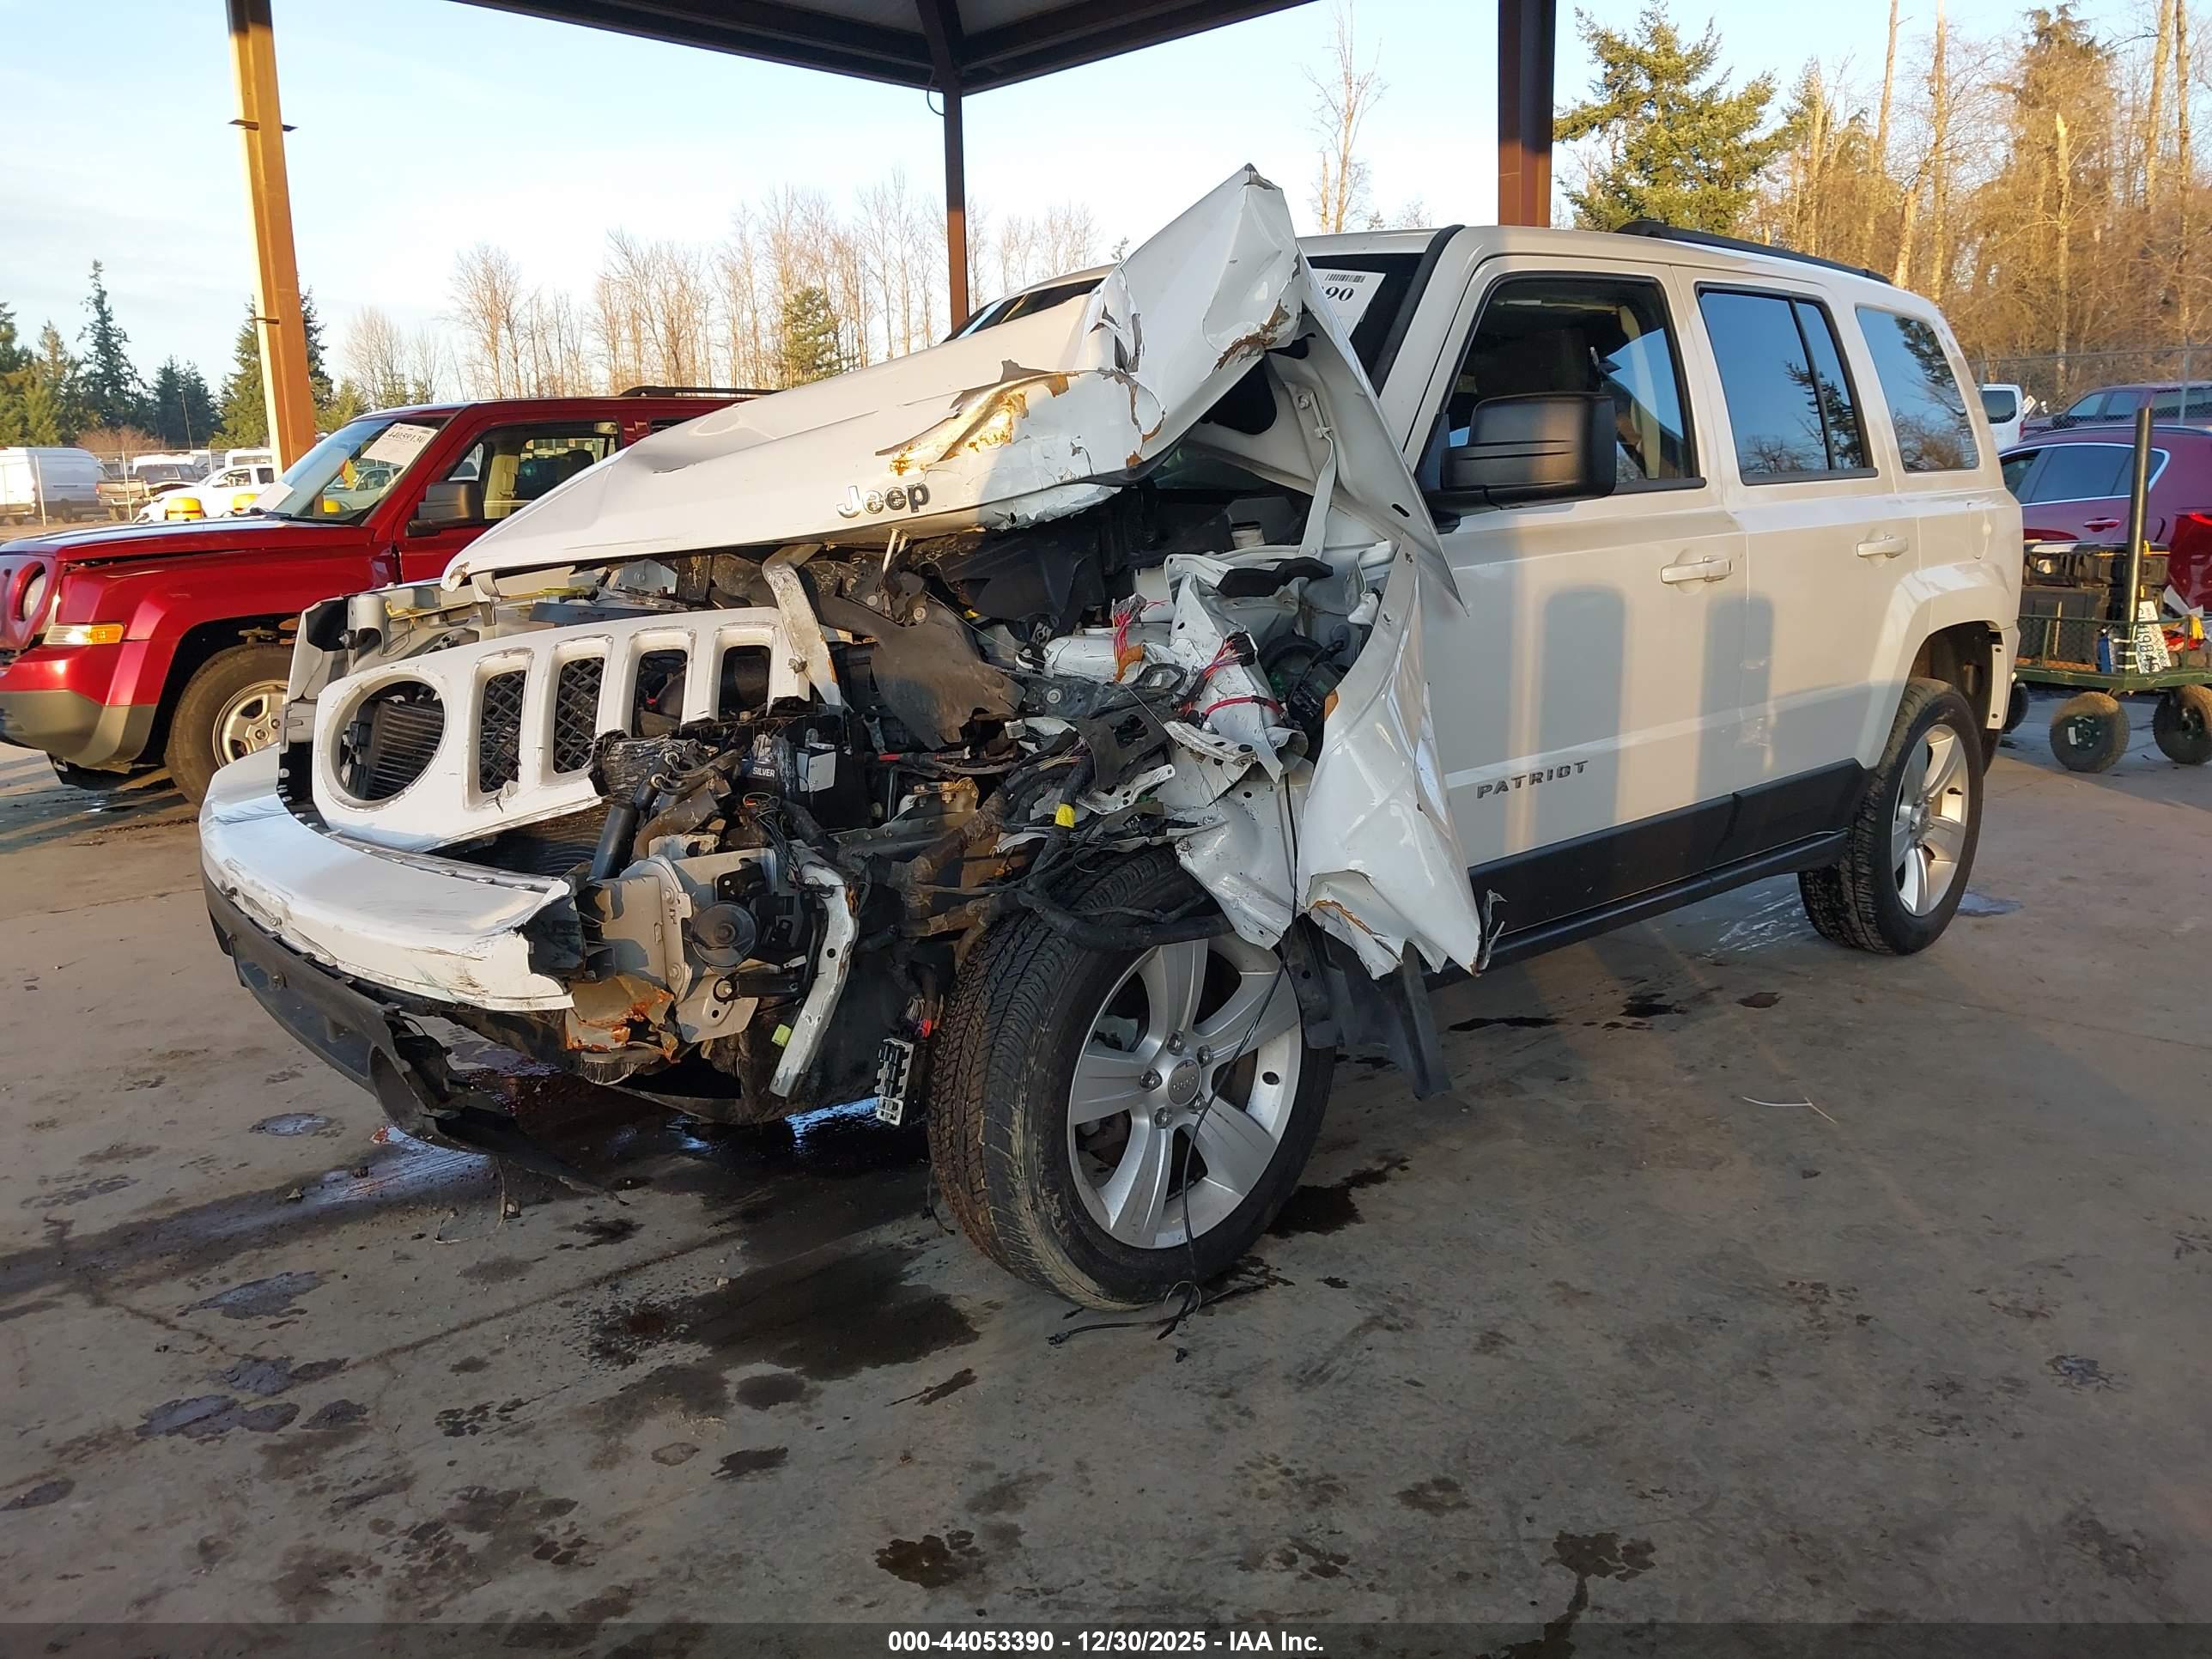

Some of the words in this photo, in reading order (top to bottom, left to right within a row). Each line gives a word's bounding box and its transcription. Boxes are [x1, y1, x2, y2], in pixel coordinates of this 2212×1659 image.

[1321, 285, 1355, 302] 90
[836, 483, 931, 519] Jeep
[752, 766, 775, 778] SILVER
[1476, 760, 1589, 799] PATRIOT
